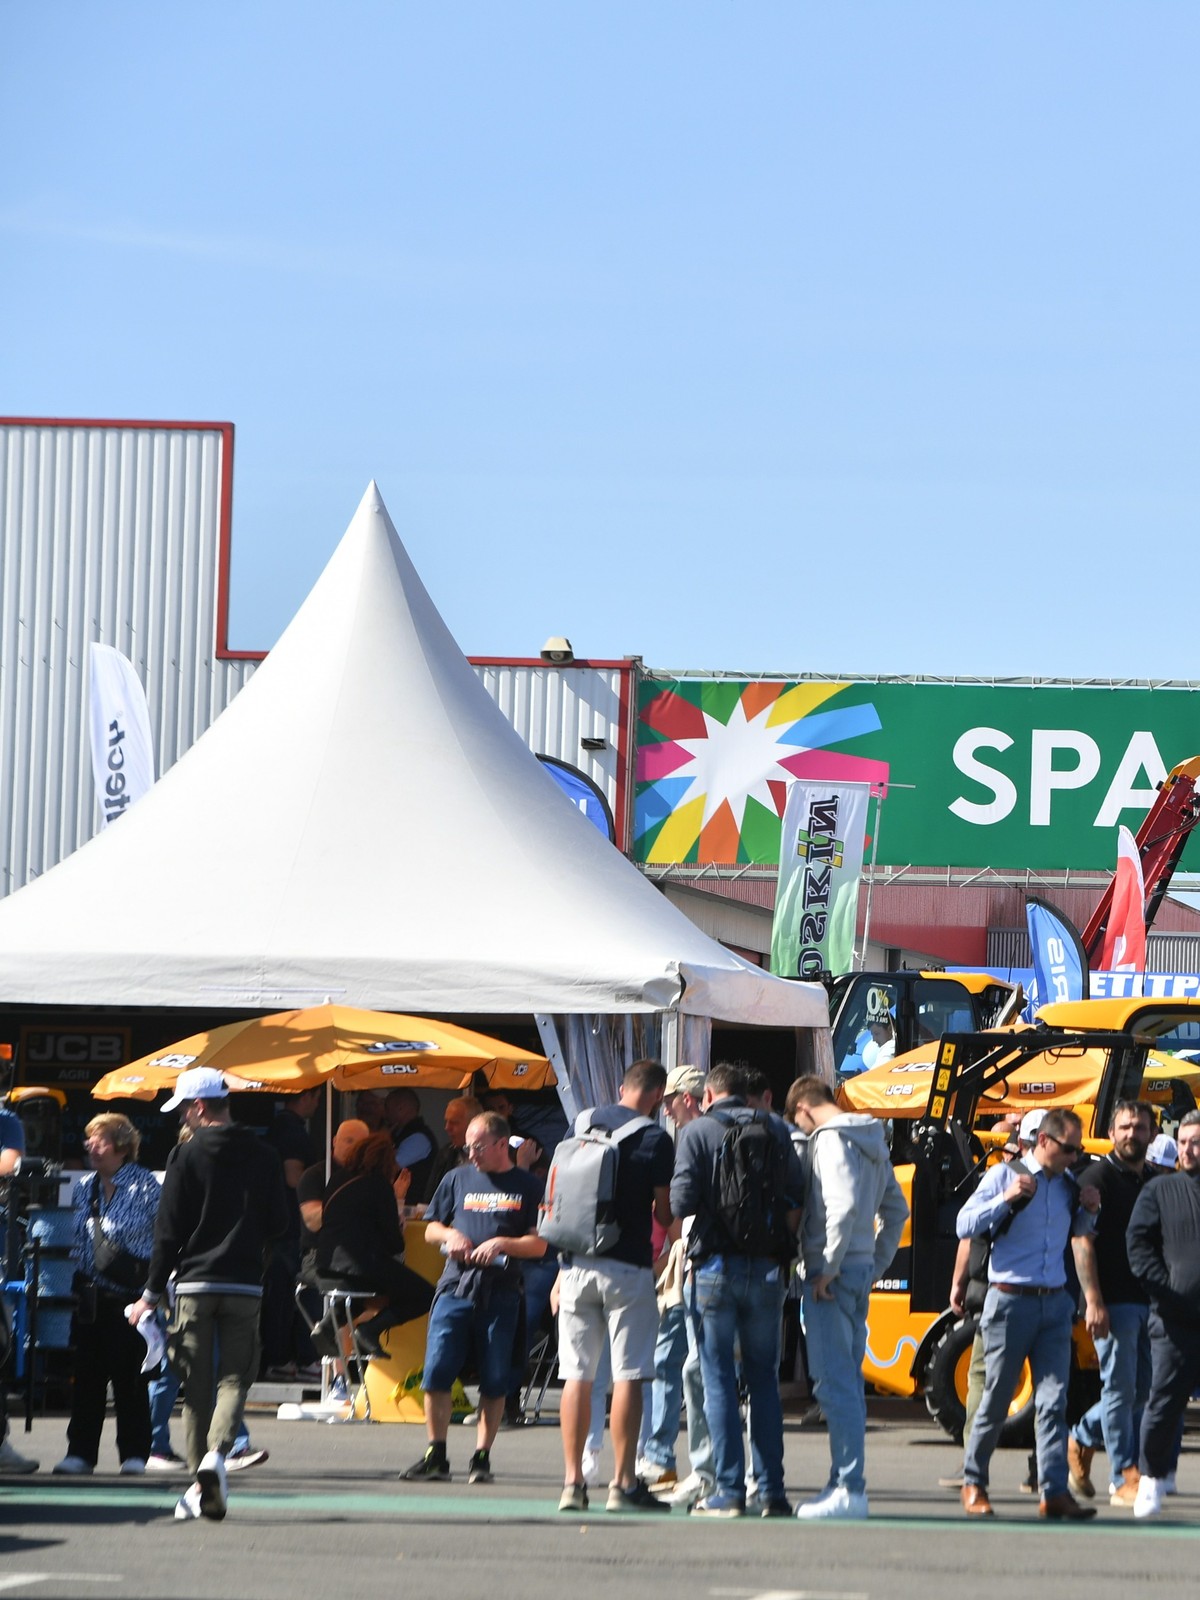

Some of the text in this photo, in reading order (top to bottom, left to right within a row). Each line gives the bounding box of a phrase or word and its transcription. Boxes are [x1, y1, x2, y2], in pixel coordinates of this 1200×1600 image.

[28, 1036, 122, 1061] JCB
[368, 1041, 440, 1053] JCB
[149, 1054, 197, 1068] JCB
[58, 1069, 90, 1079] AGRI
[891, 1063, 934, 1073] JC
[886, 1084, 913, 1096] JCB
[1020, 1082, 1055, 1094] JCB
